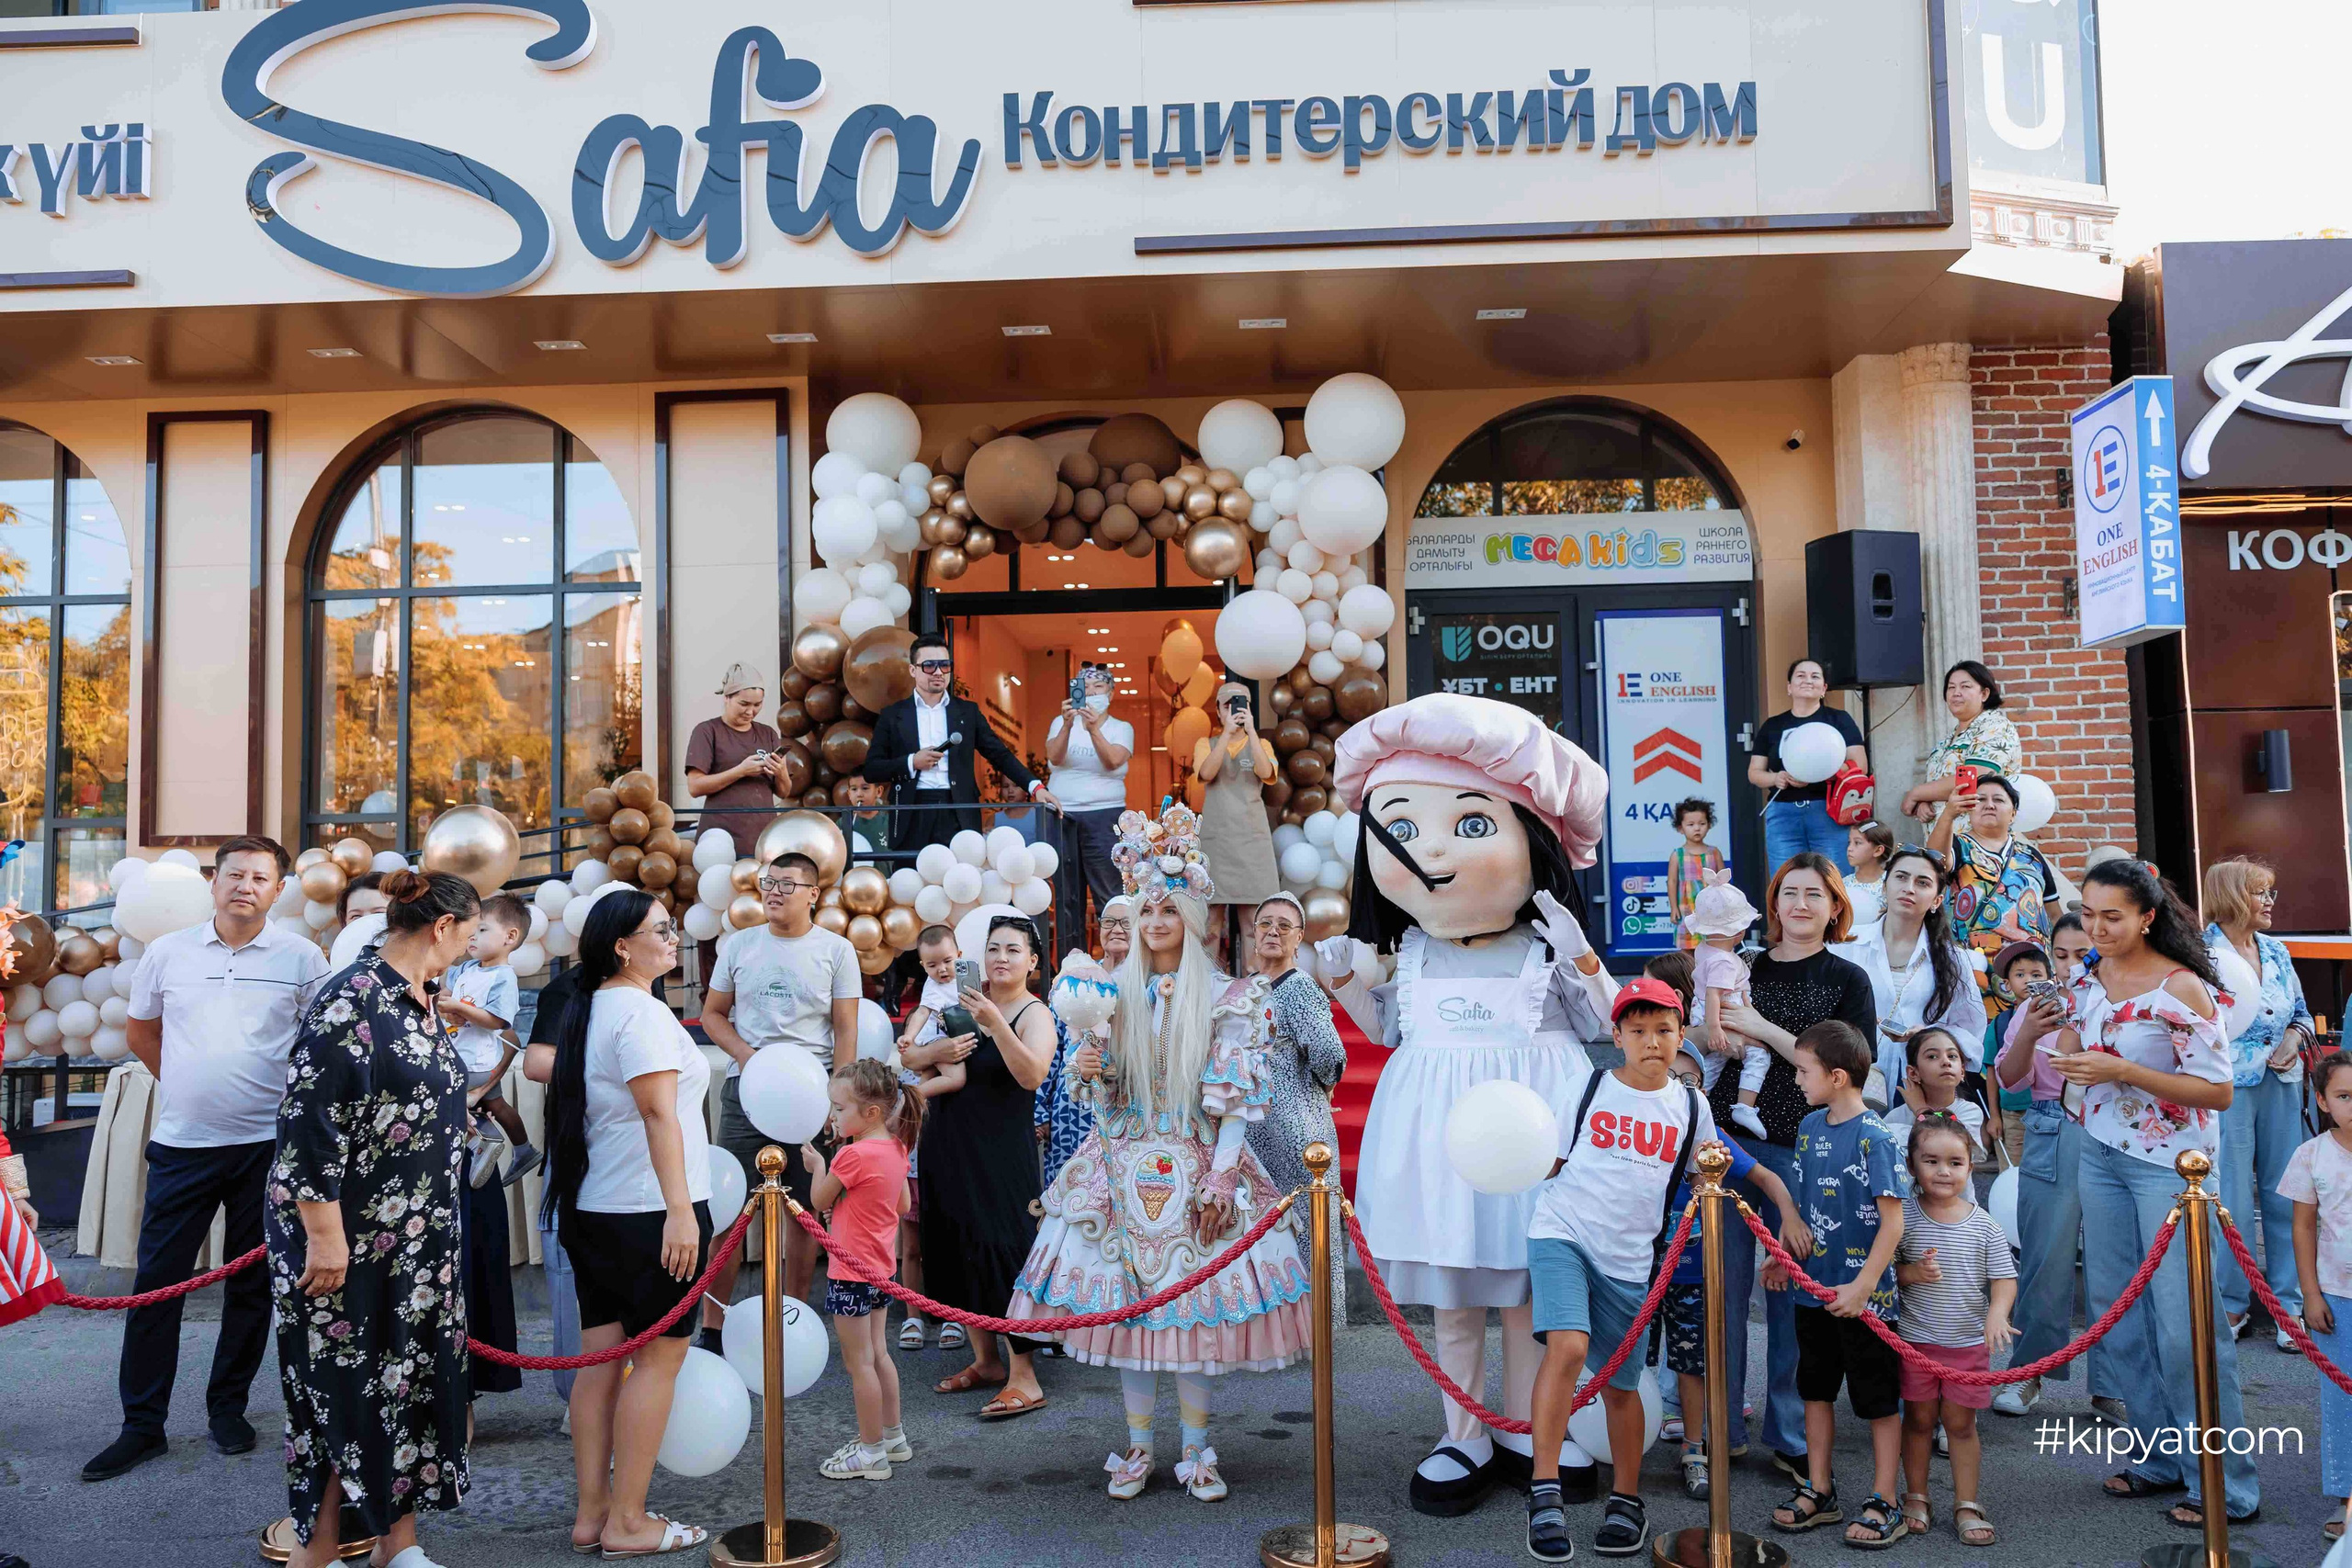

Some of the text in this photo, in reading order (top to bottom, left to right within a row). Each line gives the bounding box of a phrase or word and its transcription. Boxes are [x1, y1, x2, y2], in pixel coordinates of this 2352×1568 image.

[1002, 68, 1758, 174] Кондитерский дом
[221, 0, 985, 299] Safia
[1699, 526, 1743, 537] ШКОЛА
[2097, 522, 2124, 547] ONE
[1417, 548, 1465, 558] ДАМЫТУ
[1483, 533, 1584, 569] MEGA
[1696, 540, 1747, 551] РАННЕГО
[1693, 553, 1750, 564] РАЗВИТИЯ
[2083, 538, 2139, 576] ENGLISH
[1409, 561, 1473, 571] ОРТАЛЫҒЫ
[1477, 625, 1554, 650] OQU
[1650, 671, 1682, 682] ONE
[1510, 676, 1557, 694] ЕНТ
[1650, 685, 1716, 697] ENGLISH
[1625, 803, 1638, 819] 4
[1438, 997, 1495, 1021] Safia
[1815, 1142, 1832, 1150] RULES
